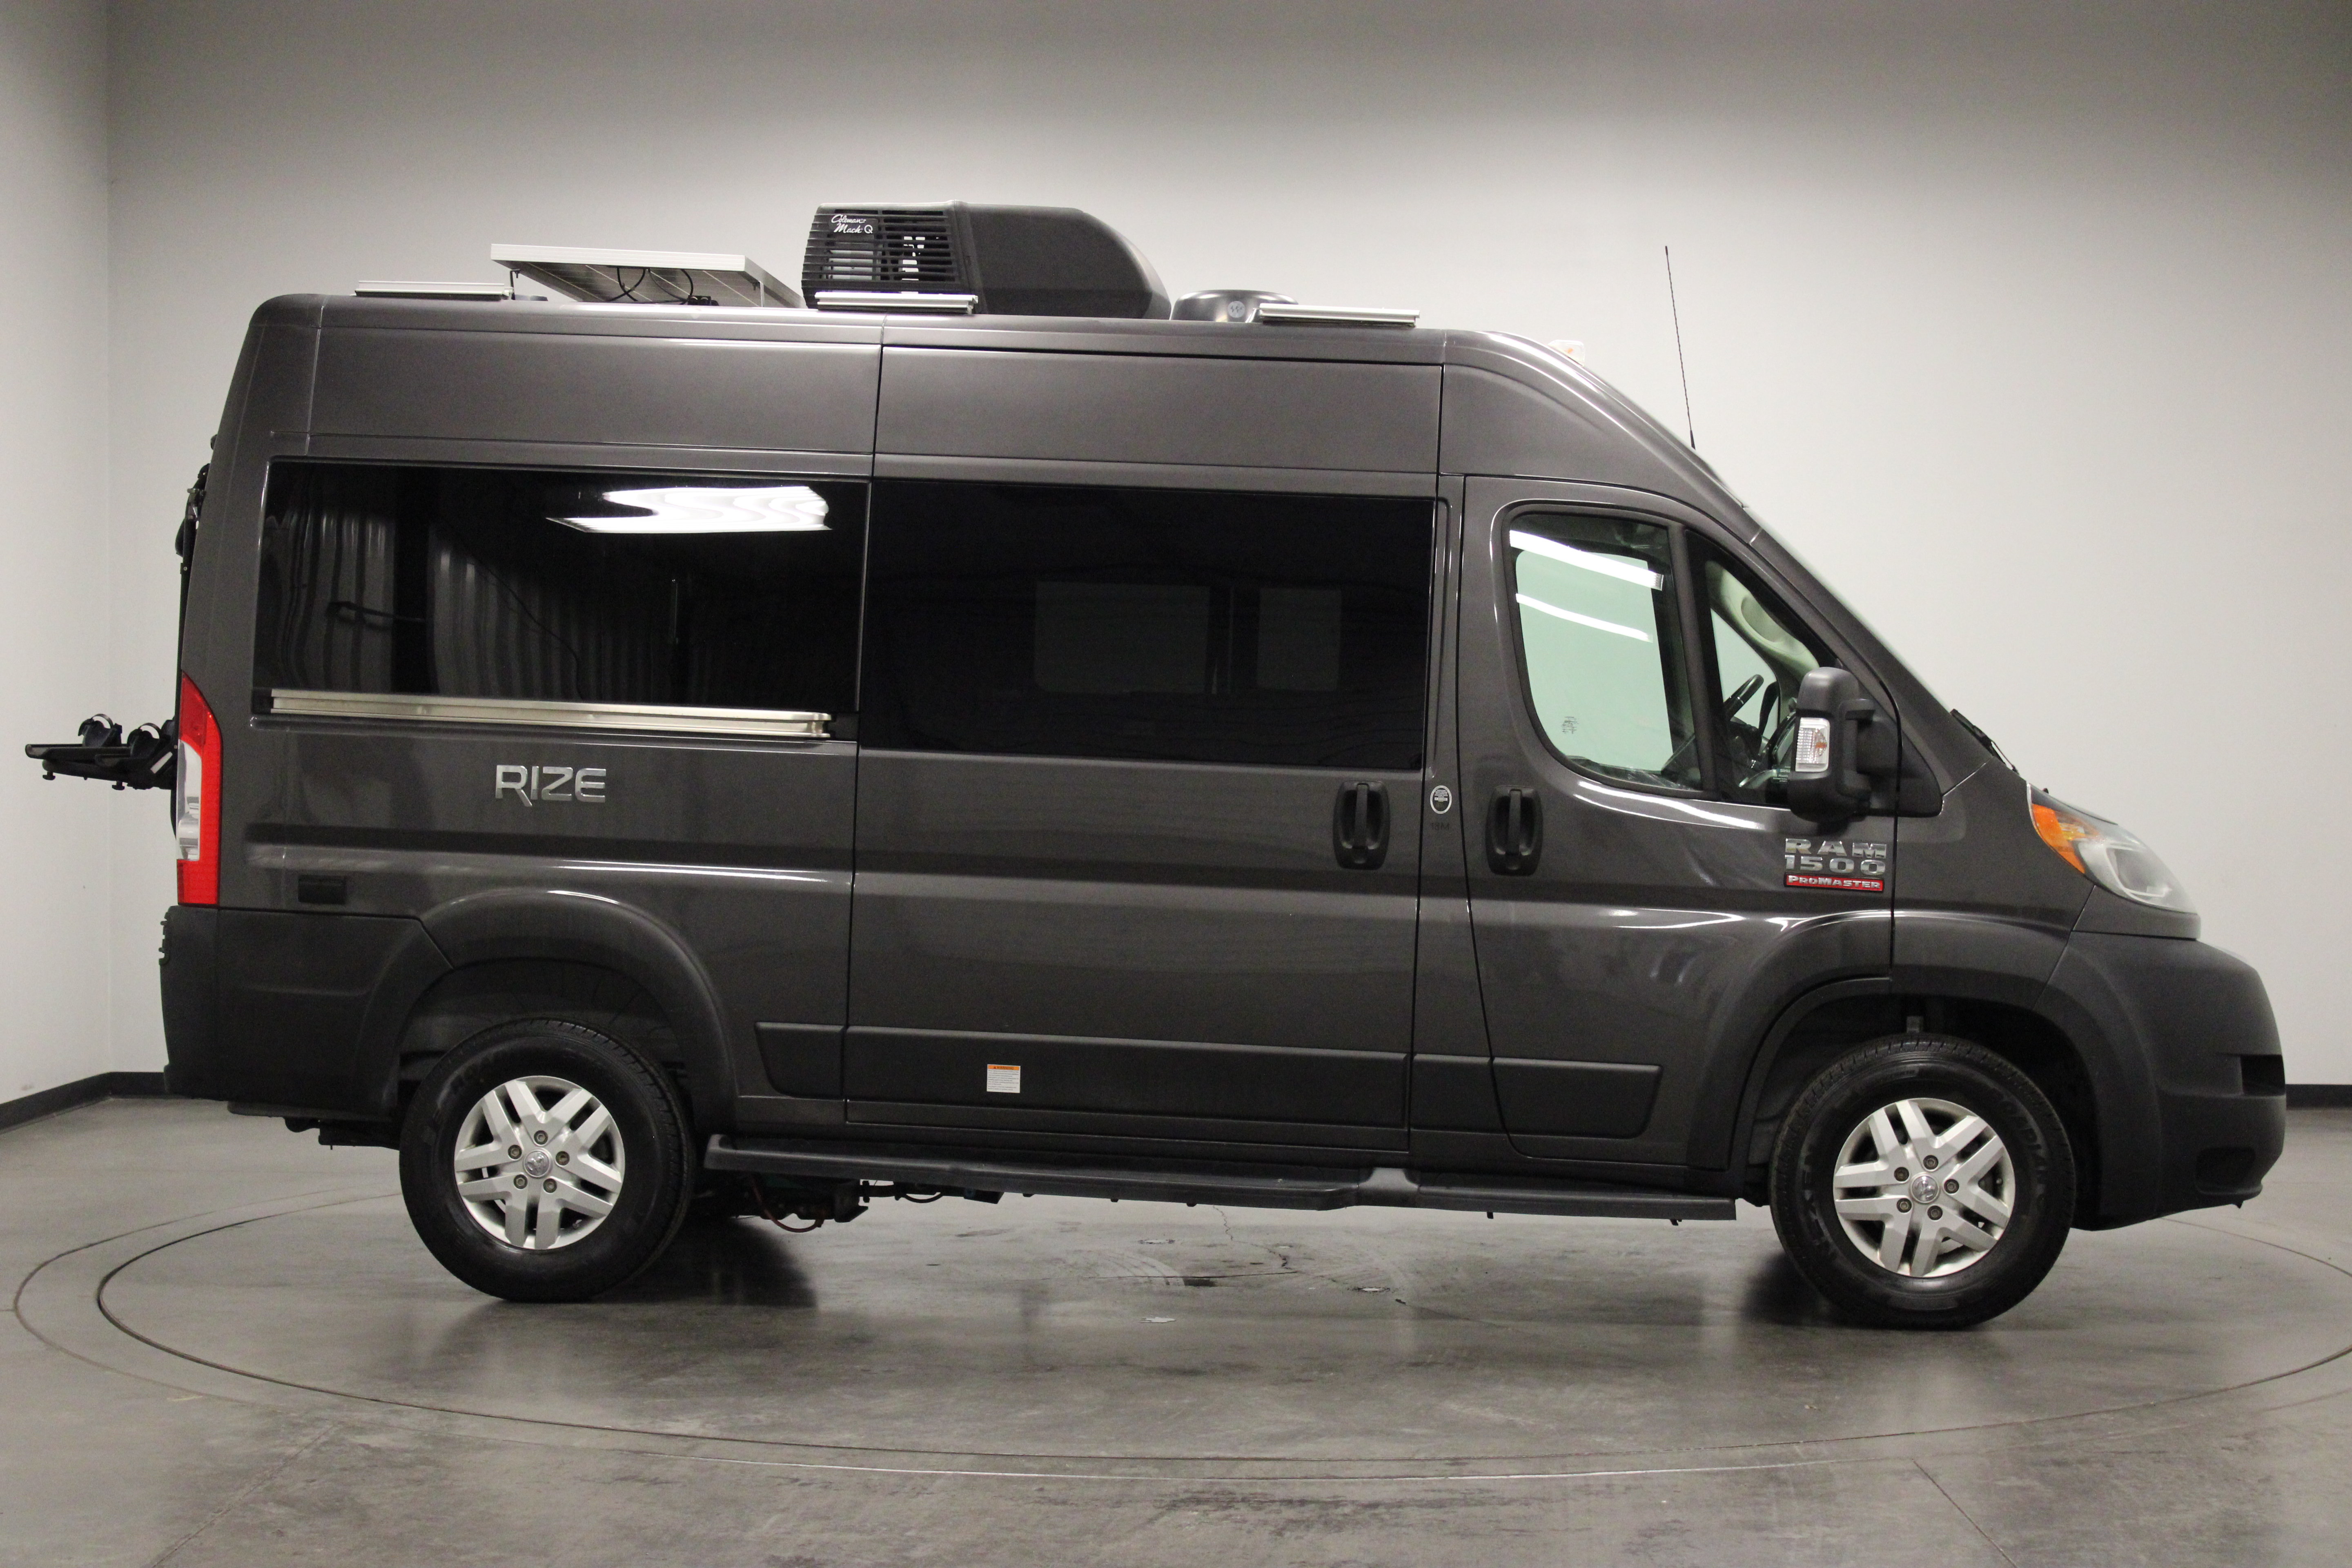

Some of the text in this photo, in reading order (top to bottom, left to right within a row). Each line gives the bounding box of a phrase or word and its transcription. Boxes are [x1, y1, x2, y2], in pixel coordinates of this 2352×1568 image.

[831, 214, 866, 223] Coleman
[833, 223, 873, 234] Mach Q
[495, 764, 607, 807] RIZE
[1785, 838, 1887, 859] RAM
[1784, 854, 1886, 876] 1500
